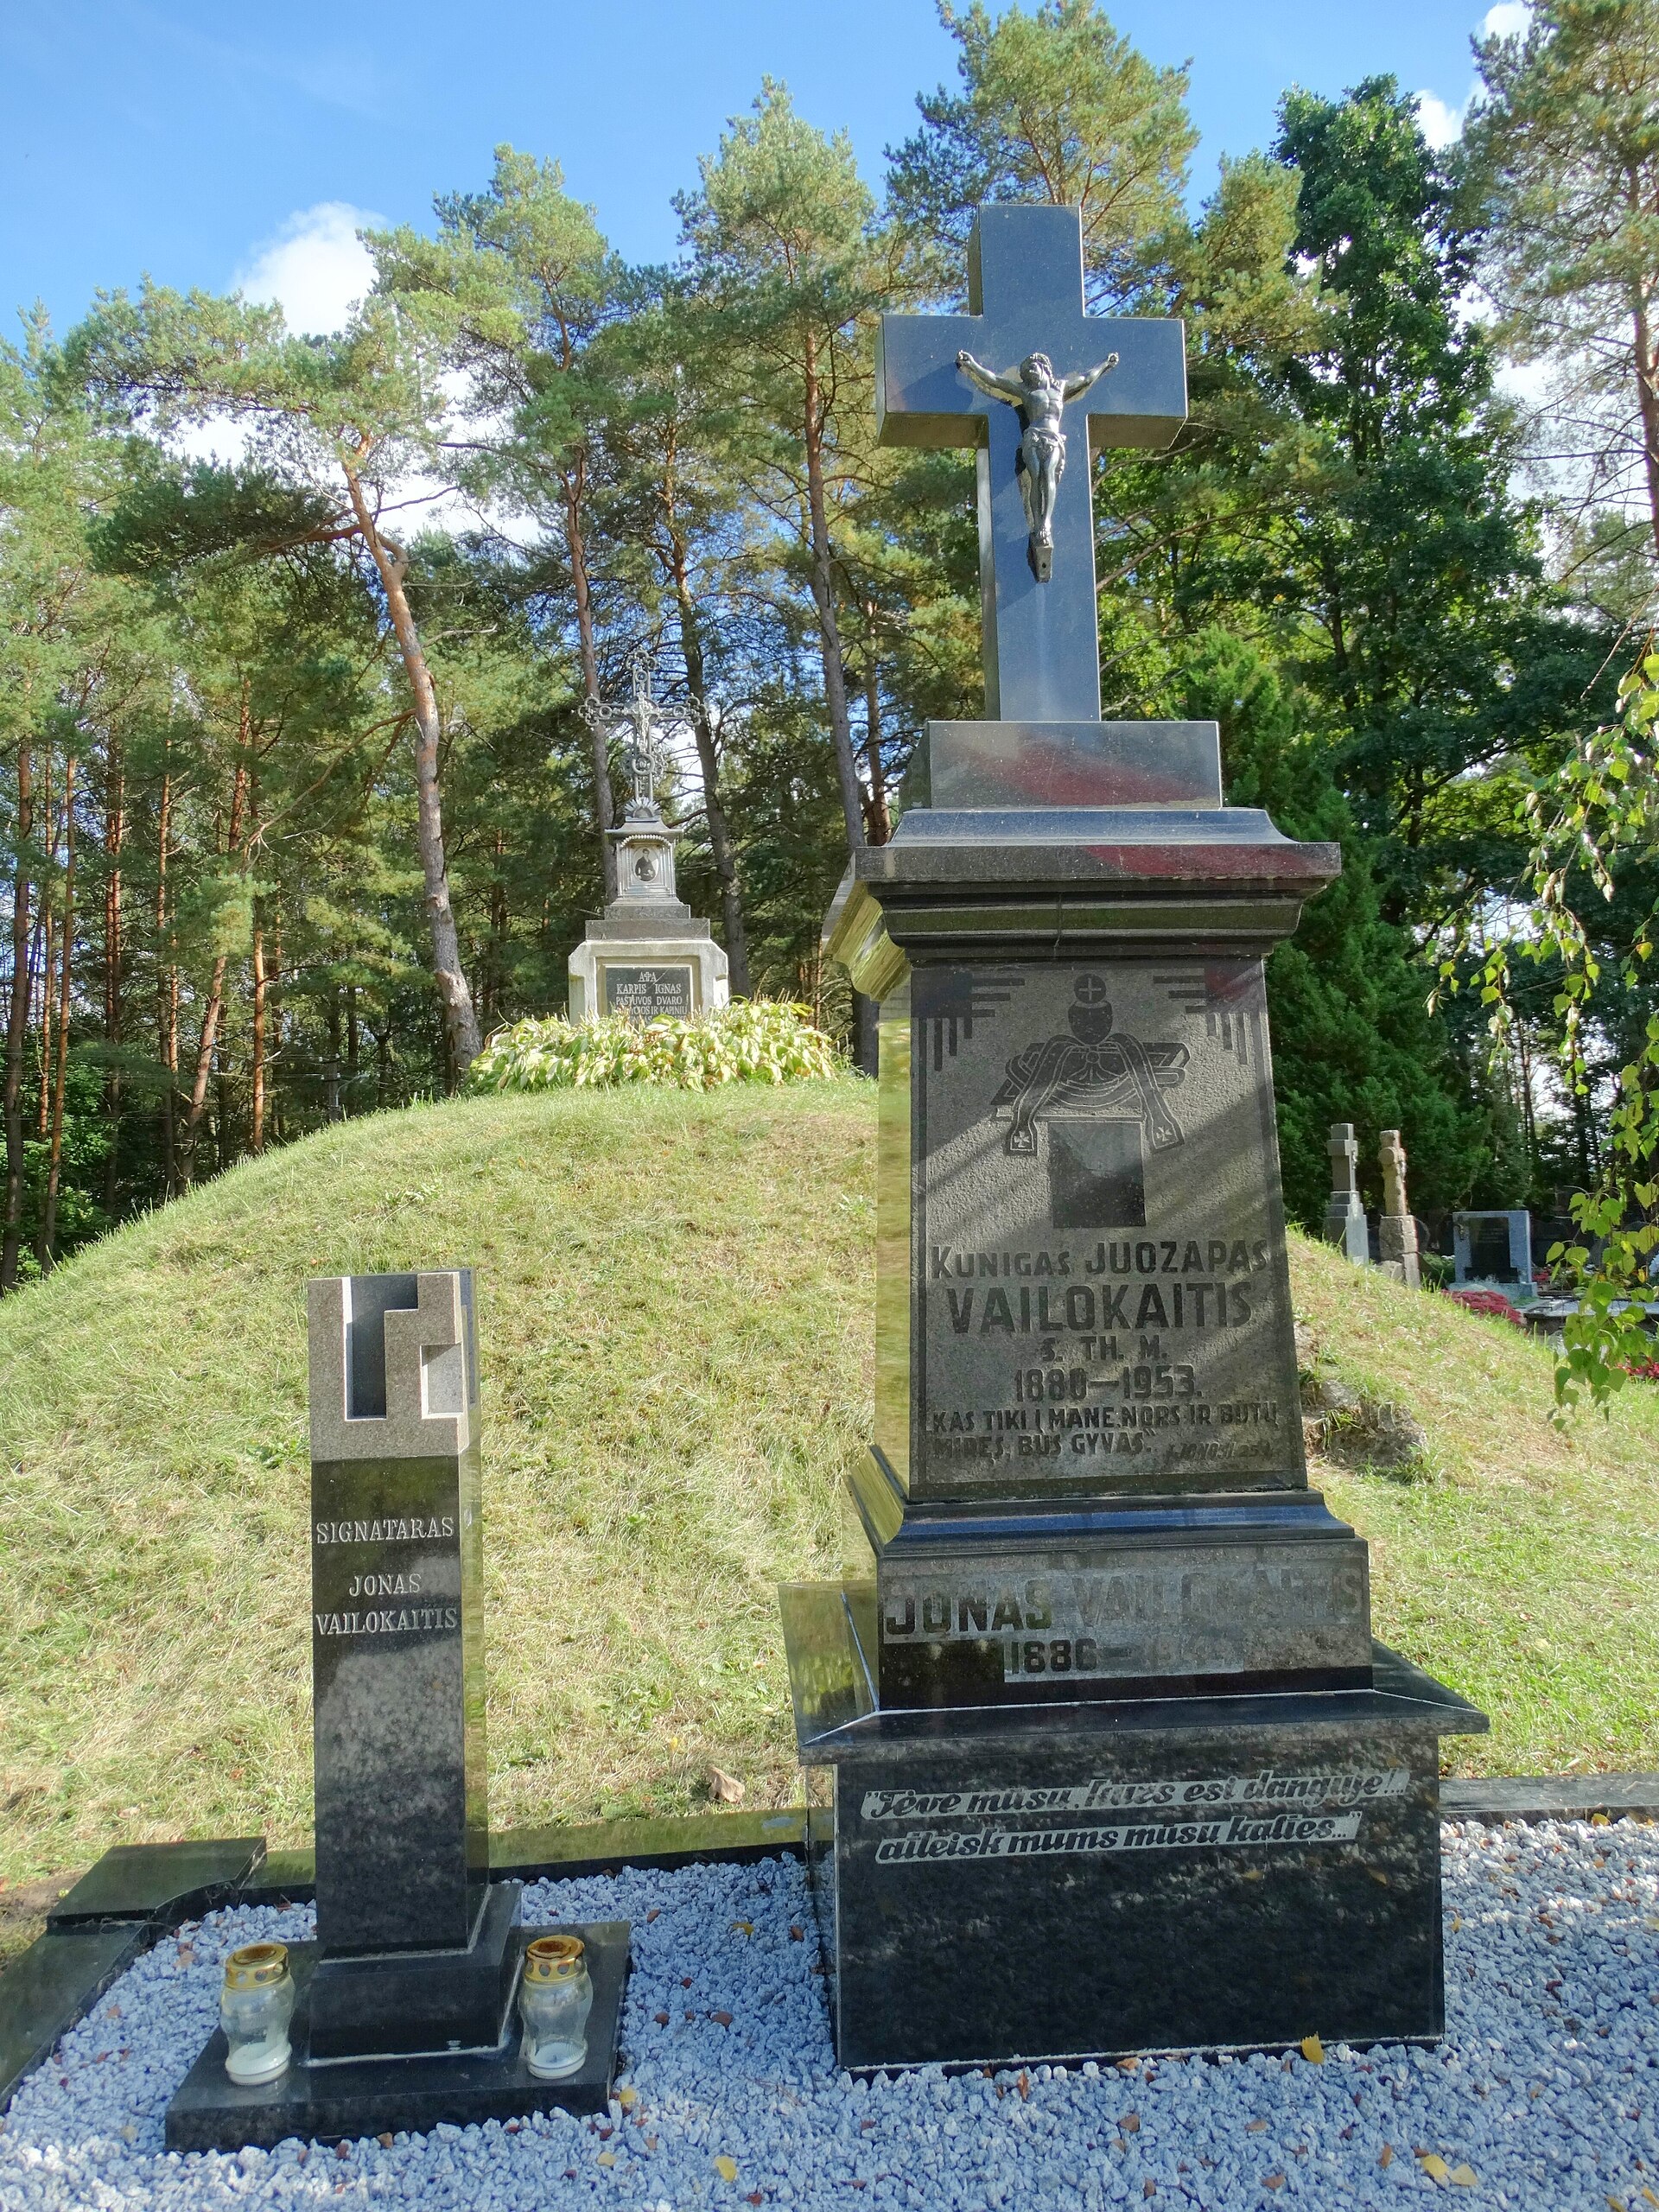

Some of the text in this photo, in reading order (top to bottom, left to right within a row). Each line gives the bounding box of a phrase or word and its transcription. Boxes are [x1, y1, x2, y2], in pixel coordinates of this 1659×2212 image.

[616, 983, 682, 995] KARPIS IGNAS
[657, 995, 683, 1006] DVARO
[931, 1239, 1268, 1279] KUNIGAS JUOZAPAS
[947, 1281, 1252, 1334] VAILOKAITIS
[982, 1409, 1027, 1431] TIKI
[1188, 1403, 1211, 1426] IR
[316, 1516, 454, 1544] SIGNATARAS
[349, 1573, 423, 1598] JONAS
[315, 1606, 458, 1636] VAILOKAITIS
[887, 1578, 1053, 1636] JONAS
[1183, 1777, 1238, 1802] esi
[1007, 1827, 1119, 1855] mums
